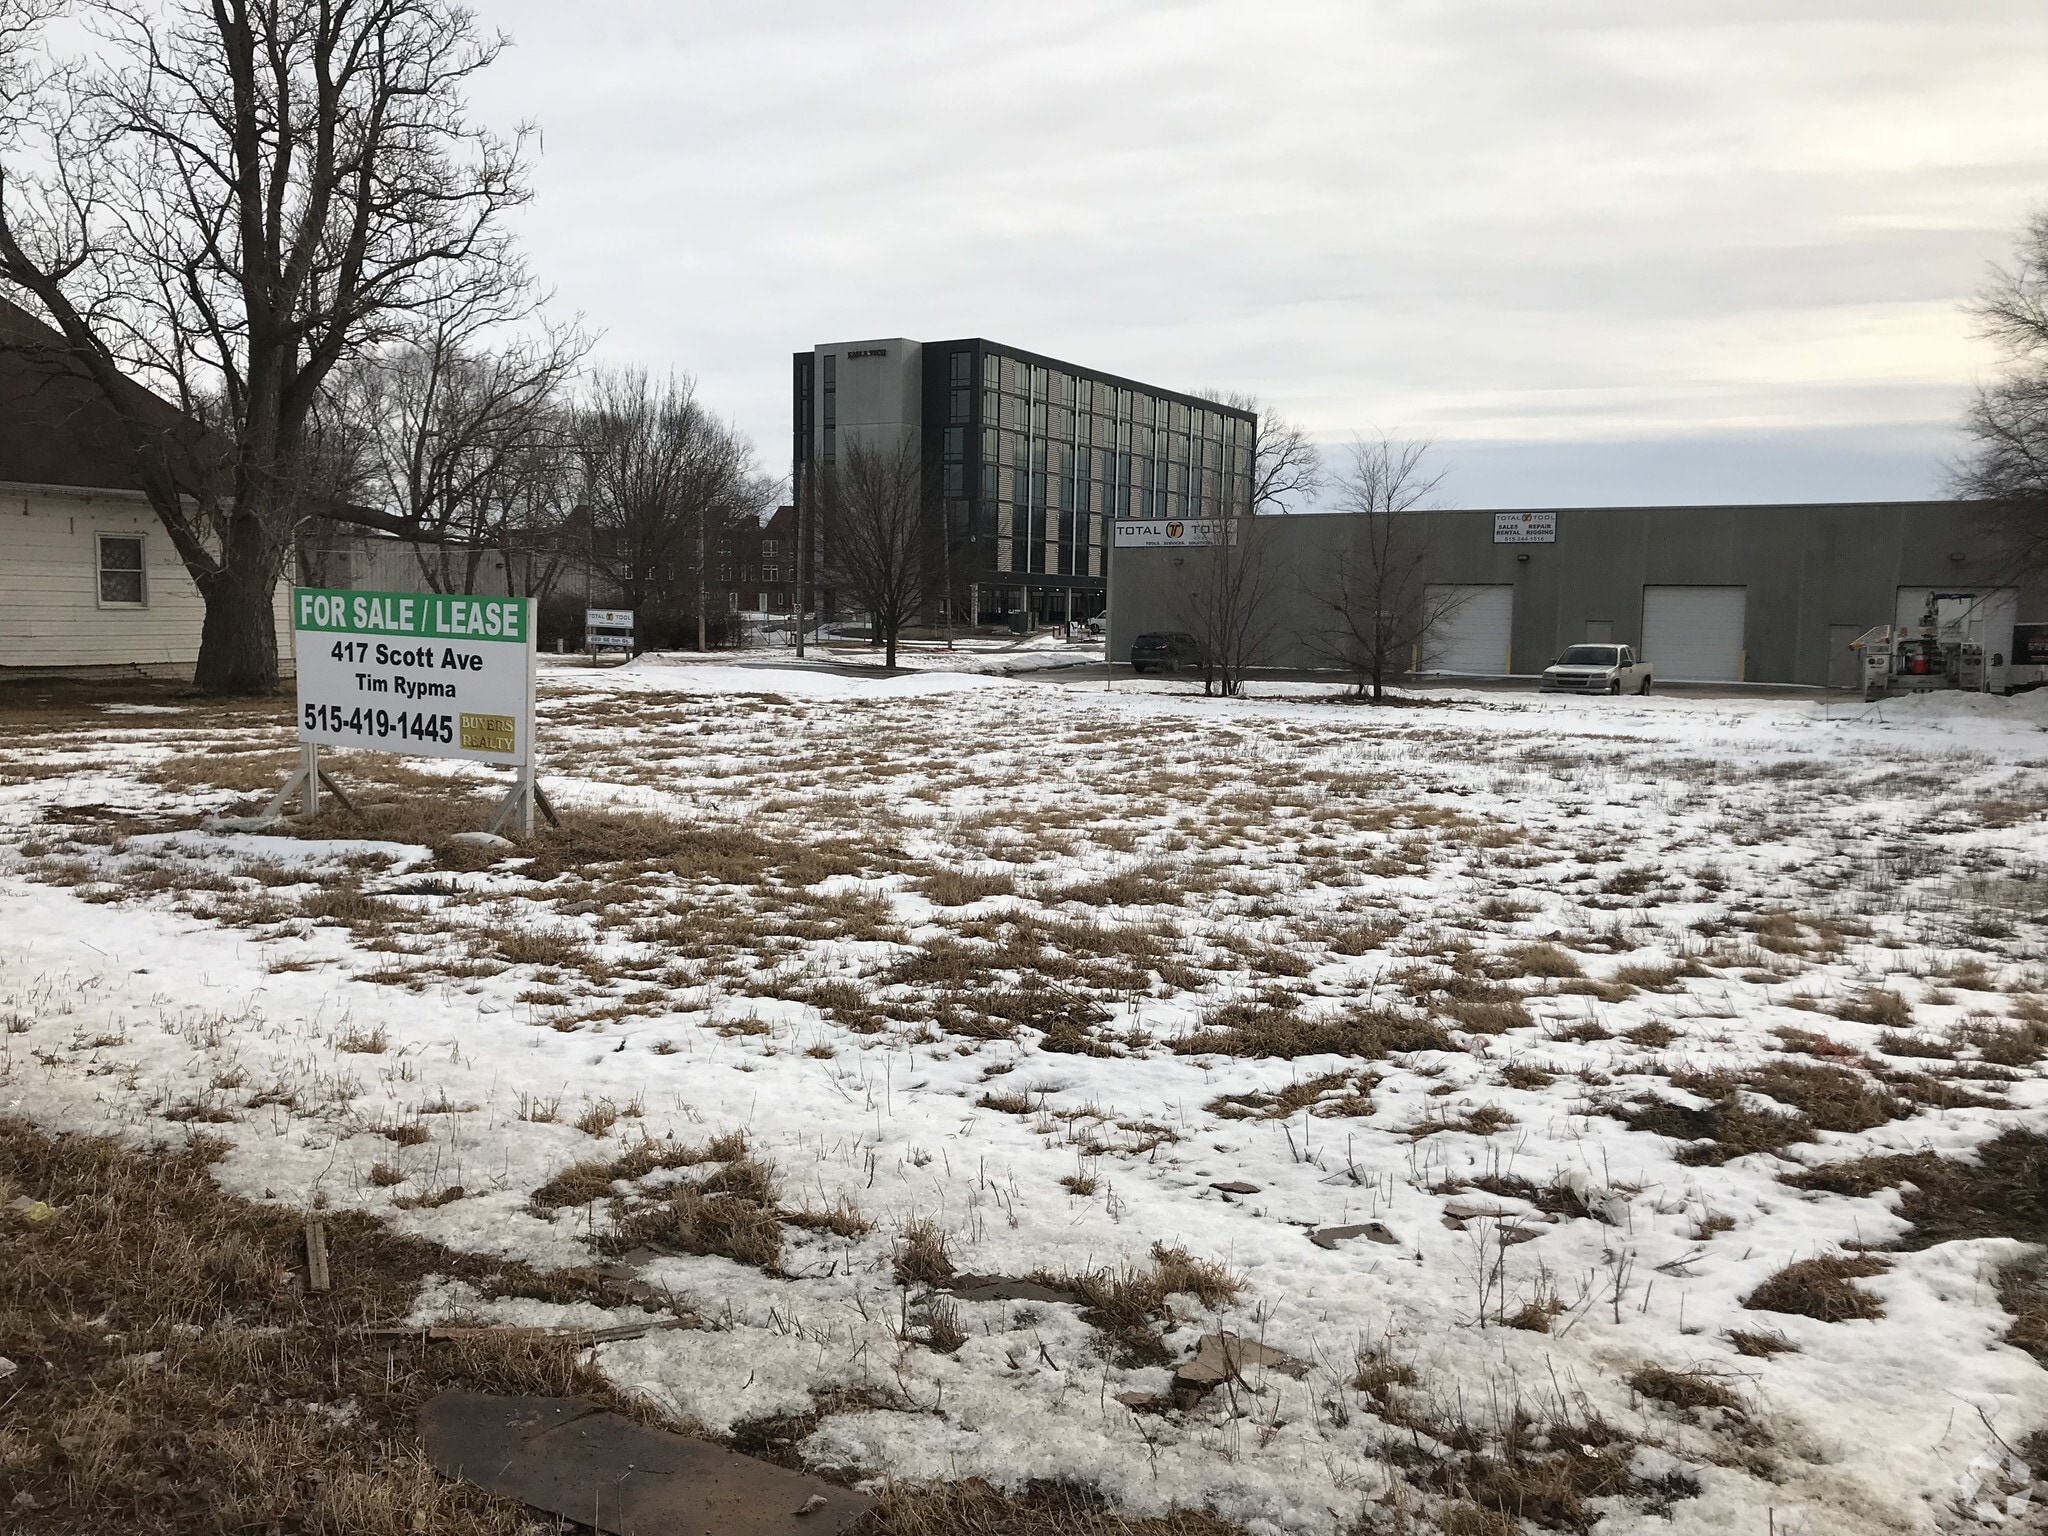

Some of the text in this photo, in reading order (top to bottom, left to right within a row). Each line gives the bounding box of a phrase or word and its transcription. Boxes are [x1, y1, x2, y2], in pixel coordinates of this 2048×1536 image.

[1116, 526, 1161, 535] TOTAL
[300, 595, 346, 628] FOR
[353, 597, 414, 631] SALE
[436, 601, 519, 637] LEASE
[331, 641, 483, 671] 417 Scott Ave
[355, 673, 456, 699] Tim Rypma
[304, 703, 453, 744] 515-419-1445
[461, 715, 513, 733] BUYERS
[461, 734, 513, 750] REALTY
